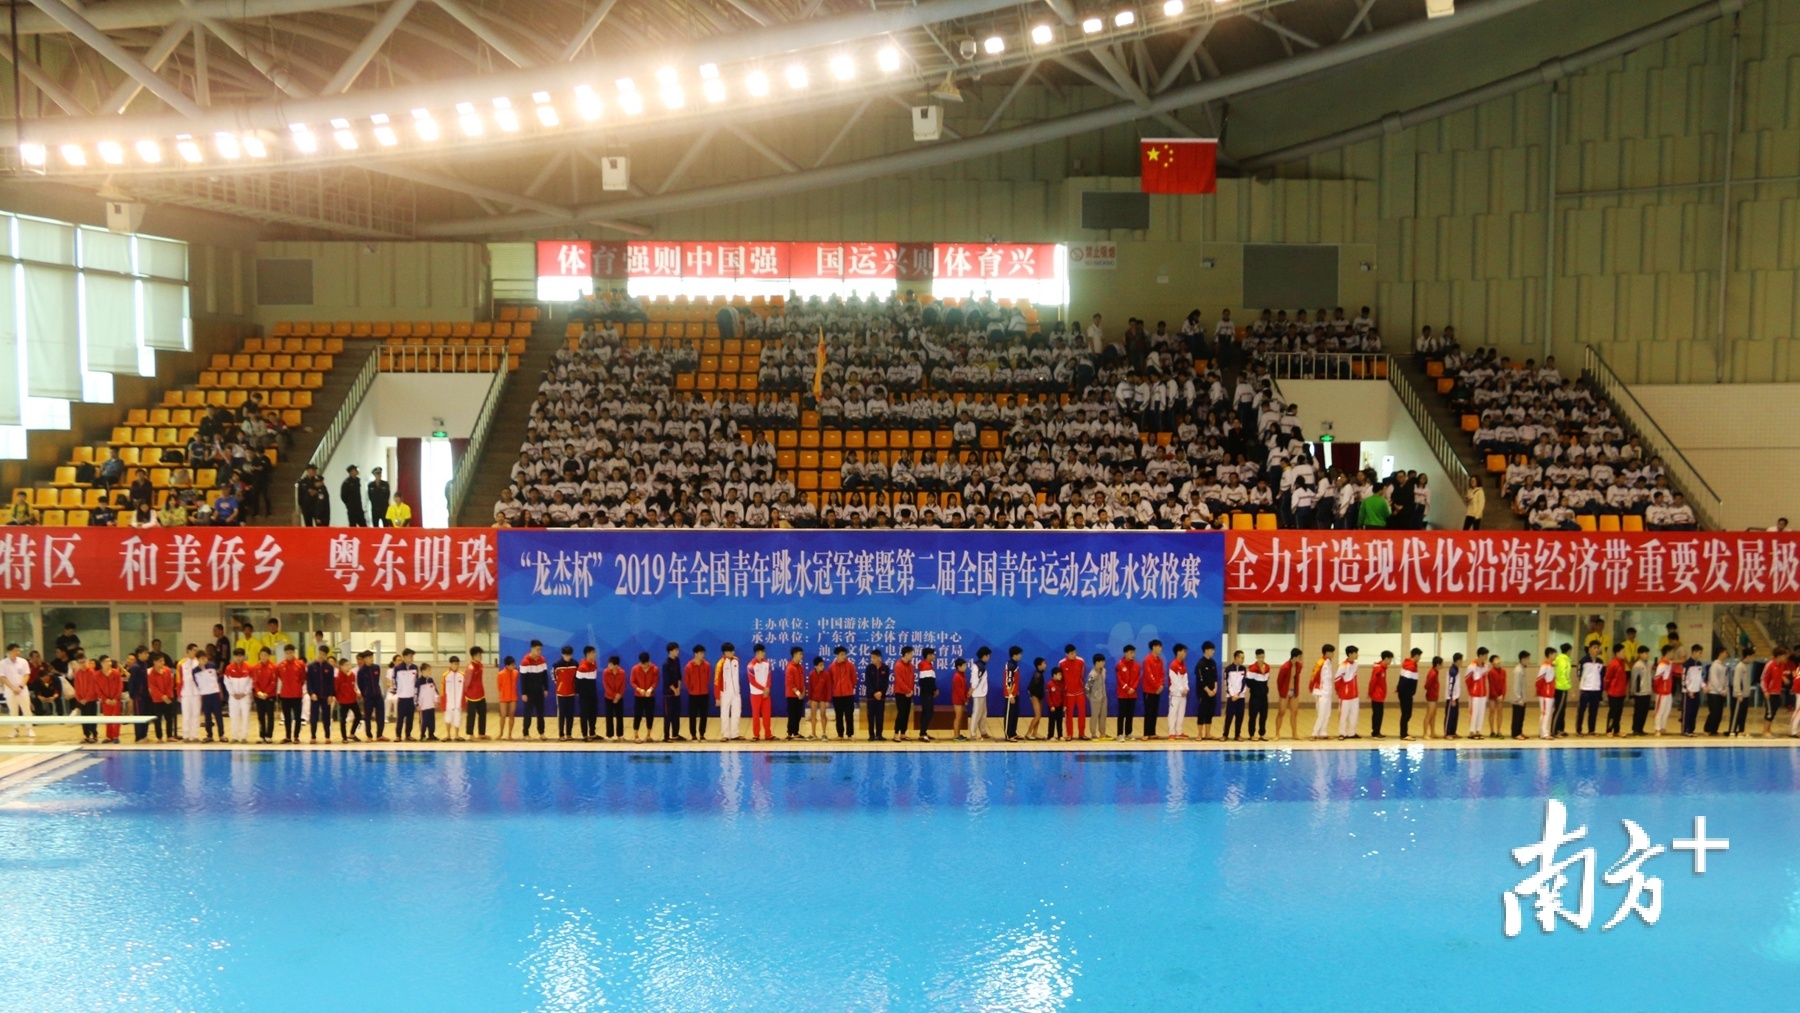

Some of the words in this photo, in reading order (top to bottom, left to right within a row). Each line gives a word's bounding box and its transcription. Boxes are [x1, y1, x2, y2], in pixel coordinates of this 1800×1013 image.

[556, 244, 779, 276] 体育强则中国强
[816, 245, 1037, 278] 国运兴则体育兴
[0, 533, 82, 591] 特区
[118, 534, 285, 592] 和美侨乡
[324, 533, 496, 592] 粤东明珠
[1226, 537, 1800, 595] 全力打造现代化沿海经济带重要发展极
